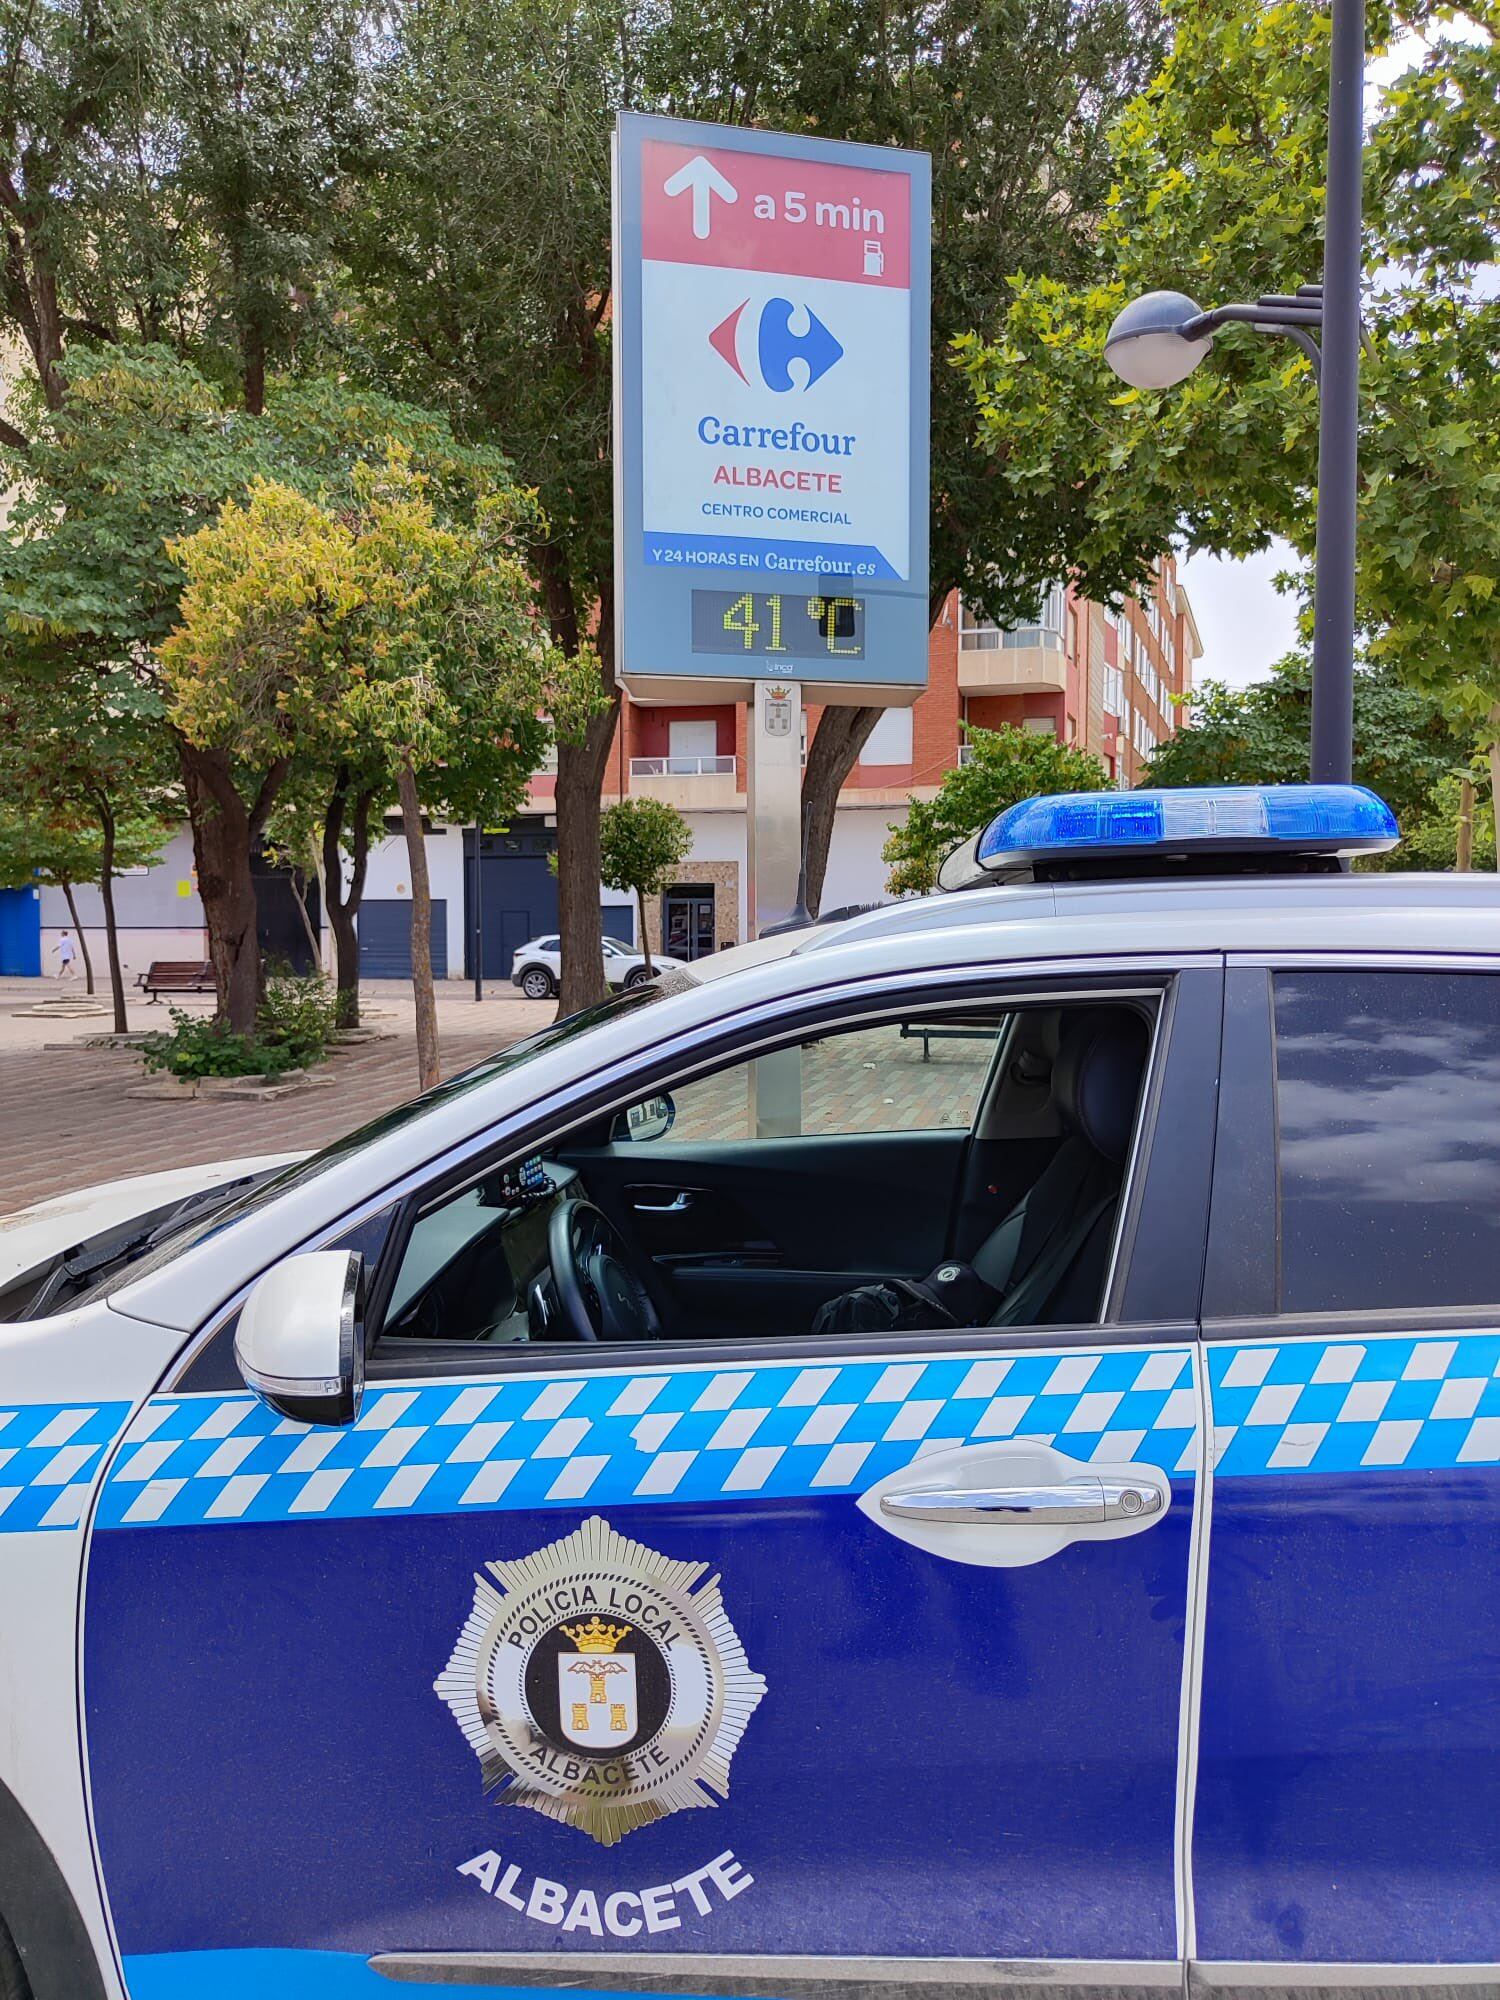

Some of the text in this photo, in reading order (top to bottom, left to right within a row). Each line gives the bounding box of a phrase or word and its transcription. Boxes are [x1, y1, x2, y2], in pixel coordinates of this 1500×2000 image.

[753, 191, 885, 235] a 5 min
[698, 416, 856, 456] Carrefour
[713, 465, 843, 493] ALBACETE
[701, 502, 852, 525] CENTRO COMERCIAL
[652, 548, 877, 576] Y 24 HORAS EN Carrefour.es
[723, 593, 787, 651] 41
[508, 1585, 681, 1652] POLICIA LOCAL
[528, 1745, 671, 1786] ALBACETE
[456, 1849, 755, 1937] ALBACETE
